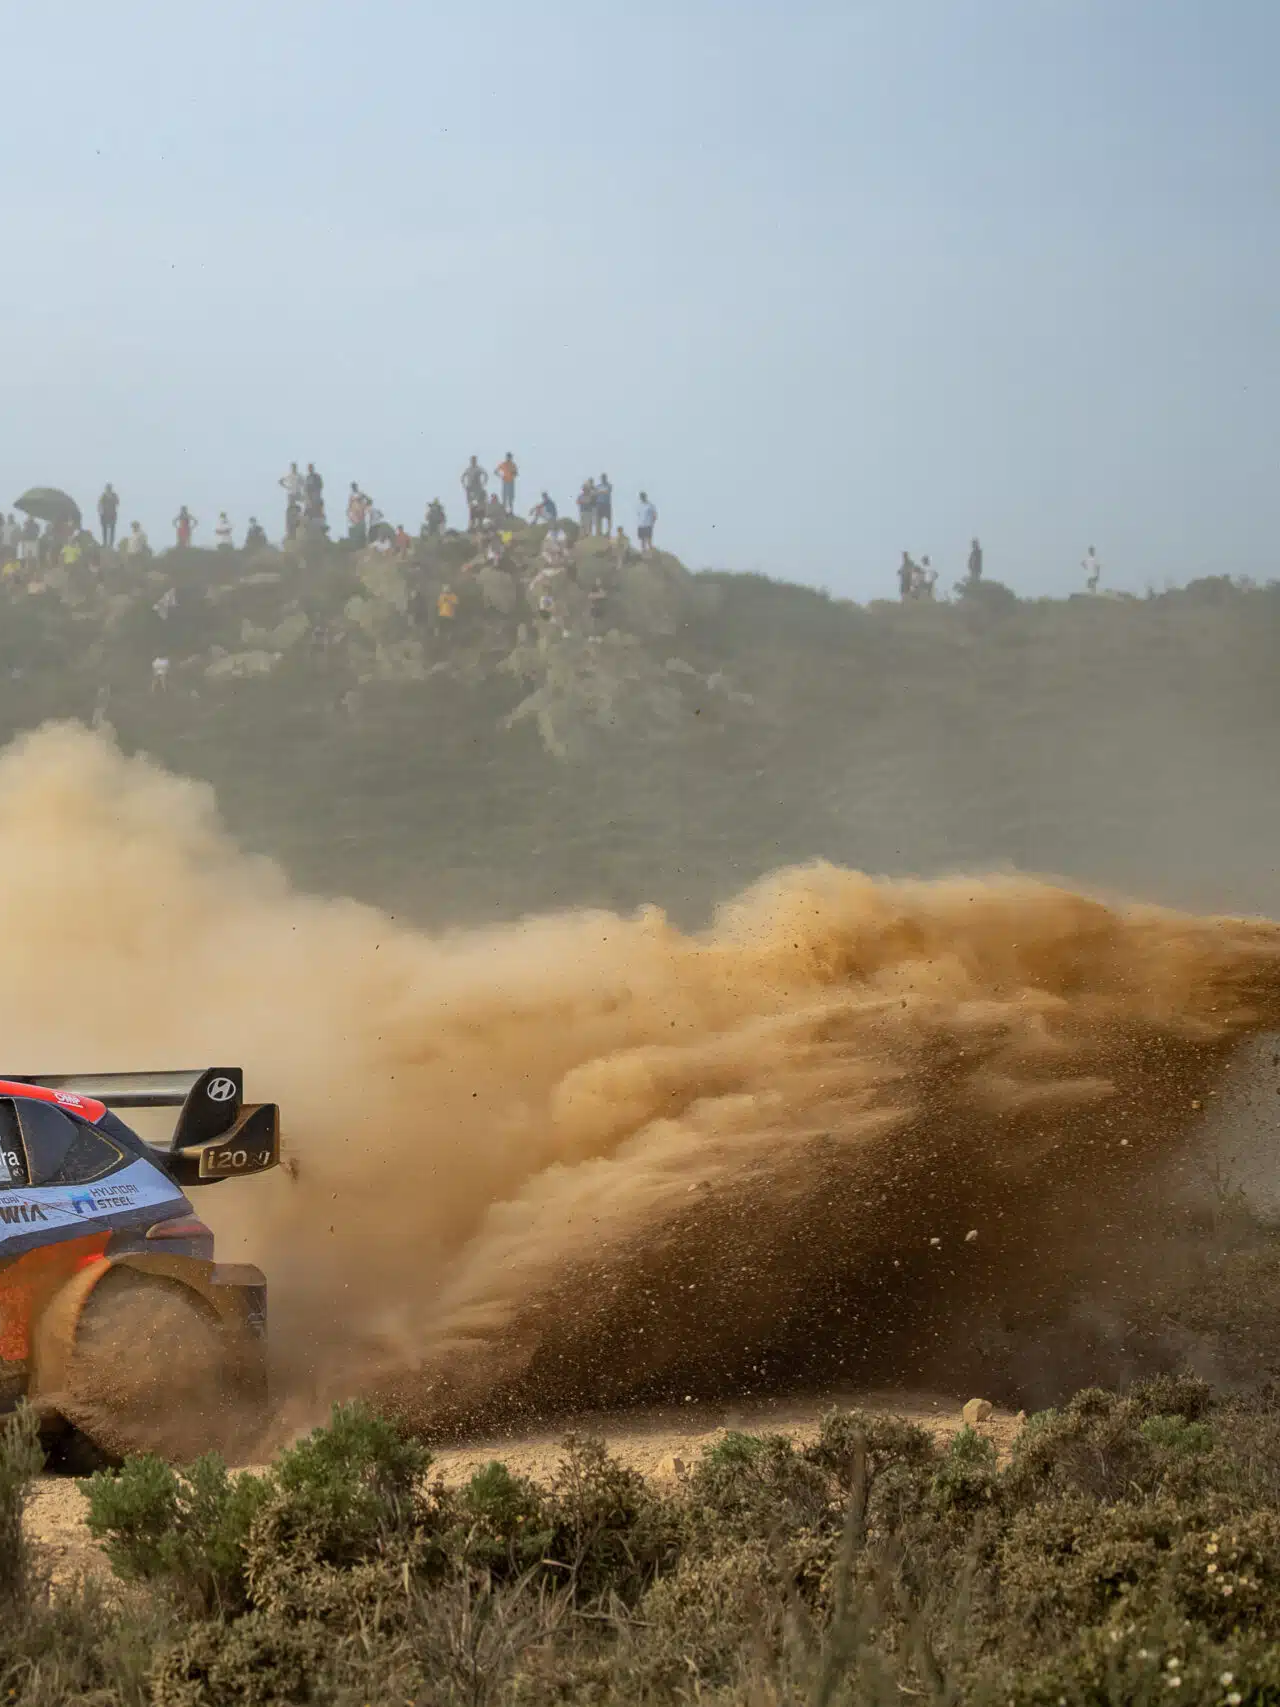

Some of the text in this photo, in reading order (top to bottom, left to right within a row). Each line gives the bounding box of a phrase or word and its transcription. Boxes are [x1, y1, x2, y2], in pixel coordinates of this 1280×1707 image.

[207, 1150, 248, 1170] i20
[89, 1184, 140, 1197] HYUNDAI
[97, 1196, 136, 1209] STEEL
